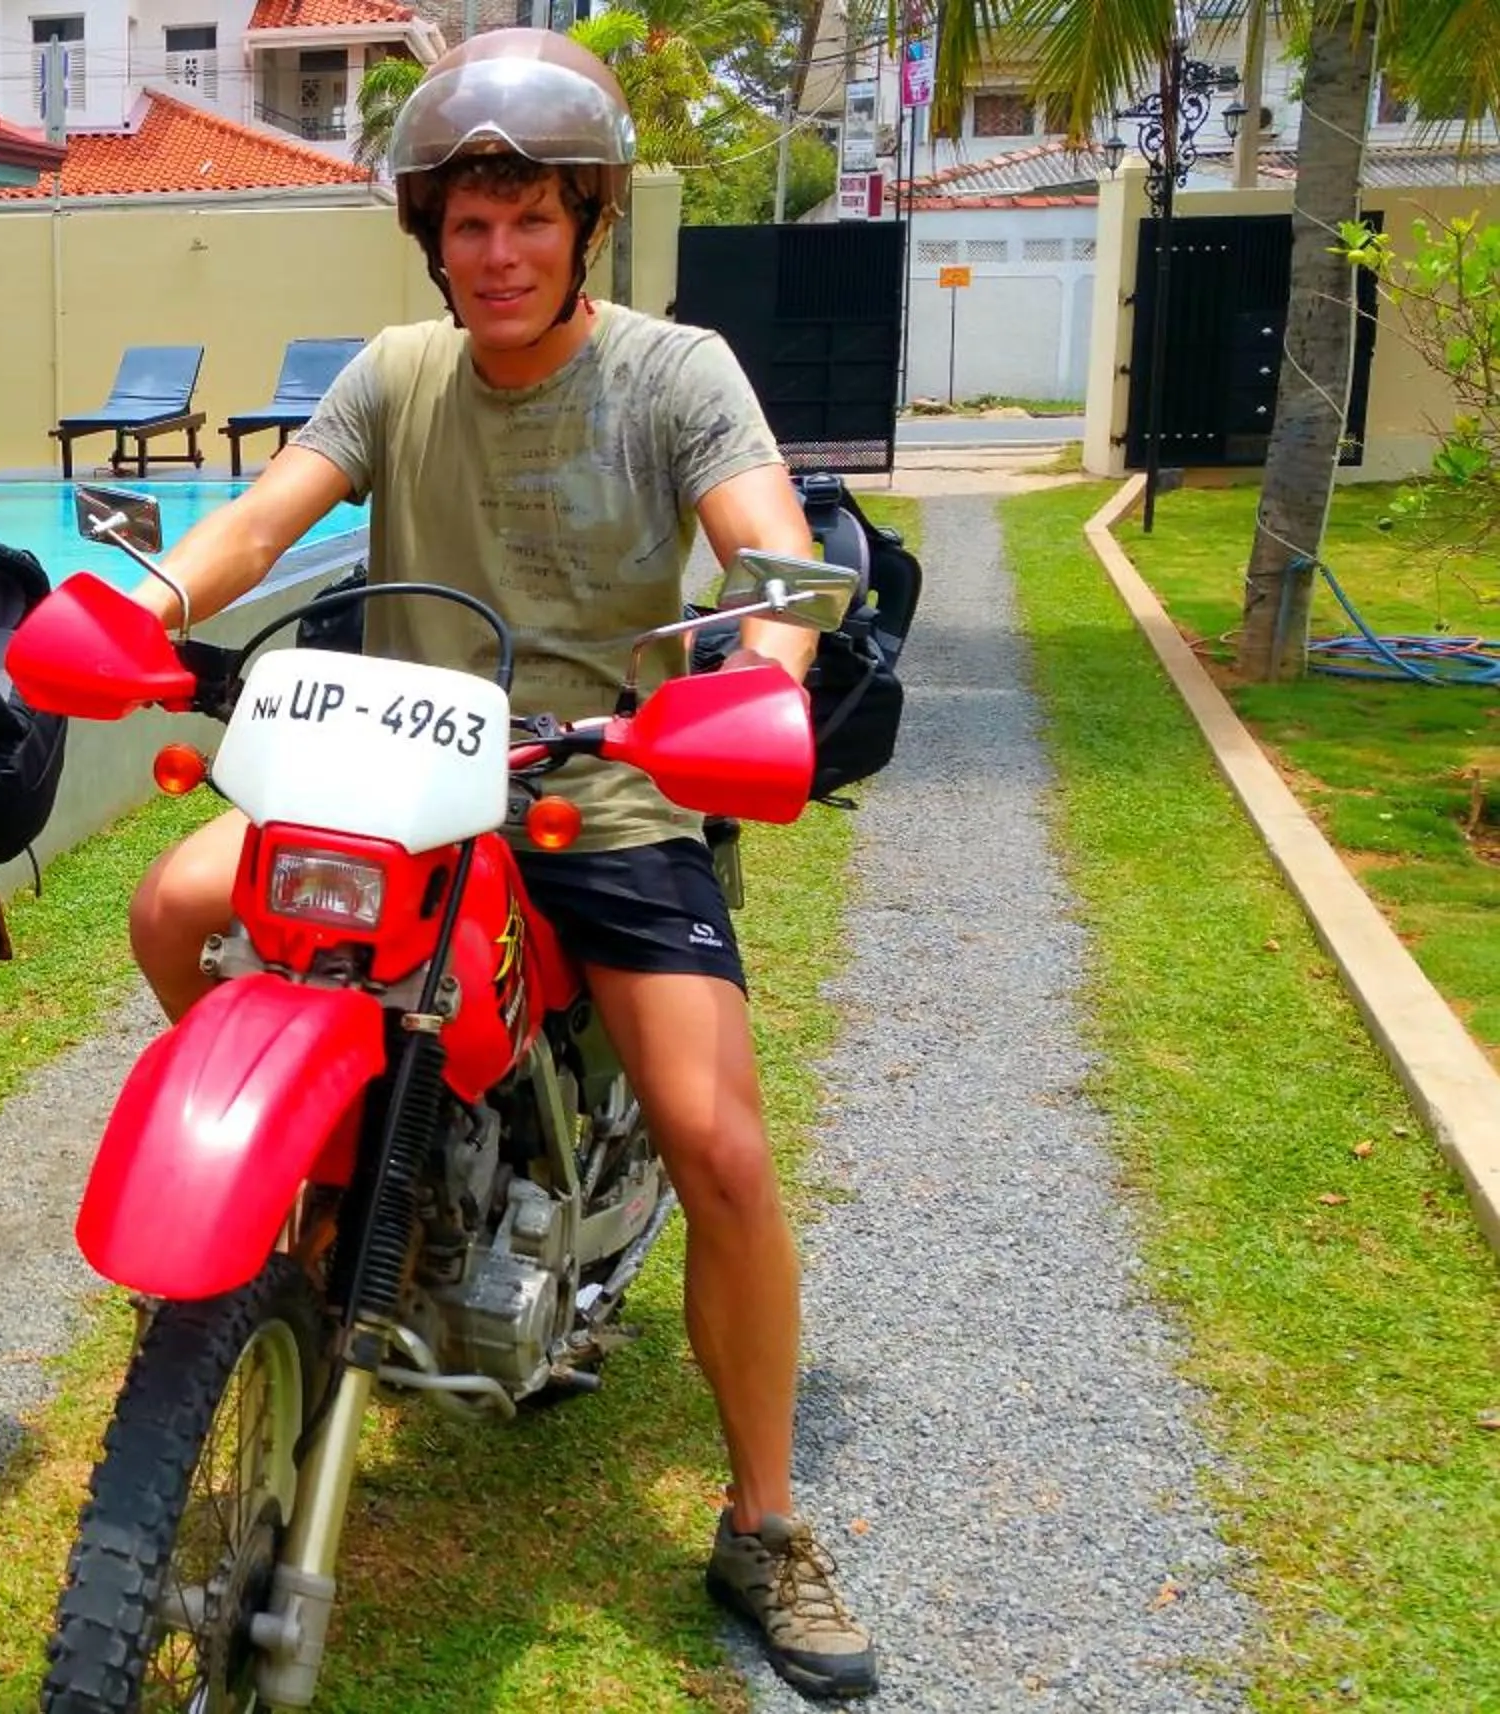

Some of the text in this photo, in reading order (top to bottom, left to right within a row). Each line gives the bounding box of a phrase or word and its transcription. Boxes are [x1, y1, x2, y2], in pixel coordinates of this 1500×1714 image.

[252, 696, 283, 721] NW
[289, 679, 345, 723] UP
[380, 695, 486, 757] 4963
